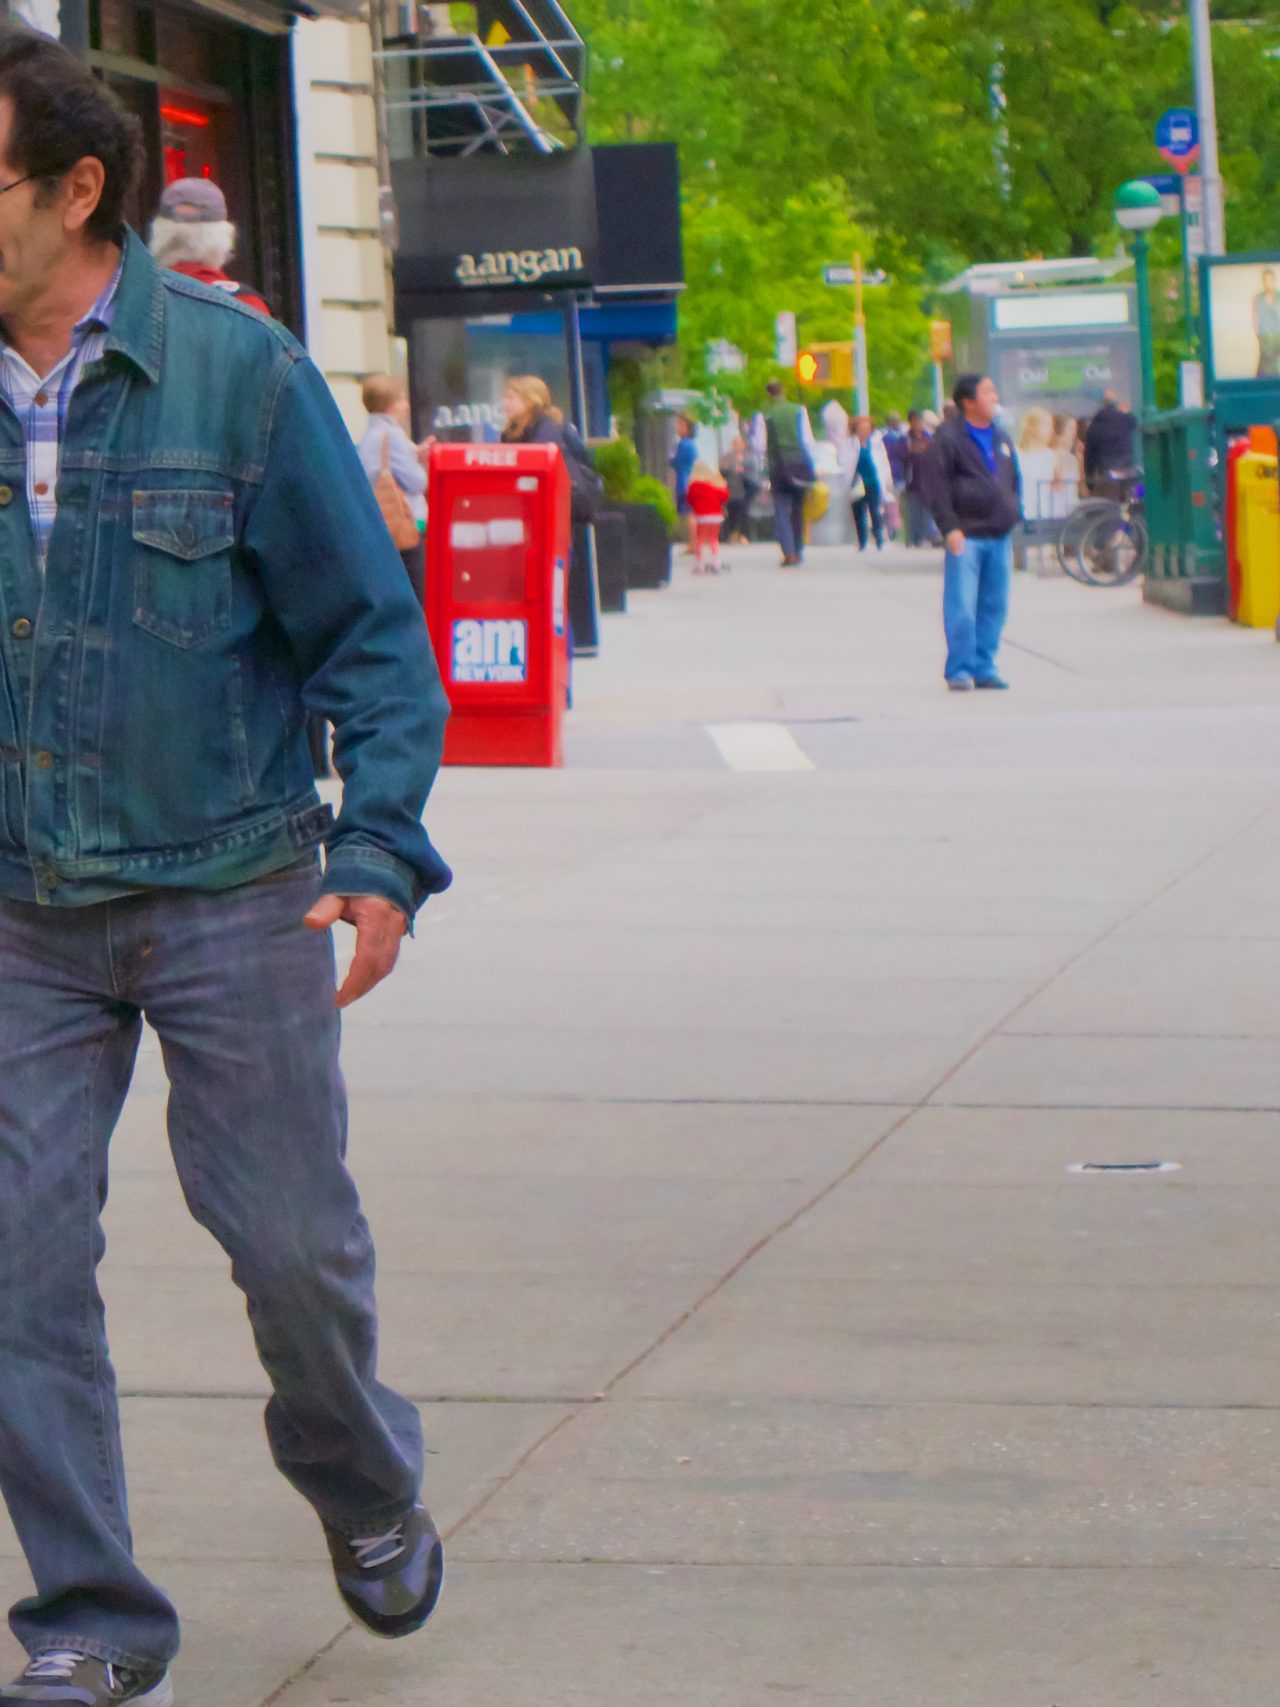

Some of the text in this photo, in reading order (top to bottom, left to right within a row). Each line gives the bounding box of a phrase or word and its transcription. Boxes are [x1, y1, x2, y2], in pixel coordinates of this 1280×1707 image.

[456, 247, 583, 282] aangan
[433, 404, 507, 432] aang
[455, 620, 525, 665] am
